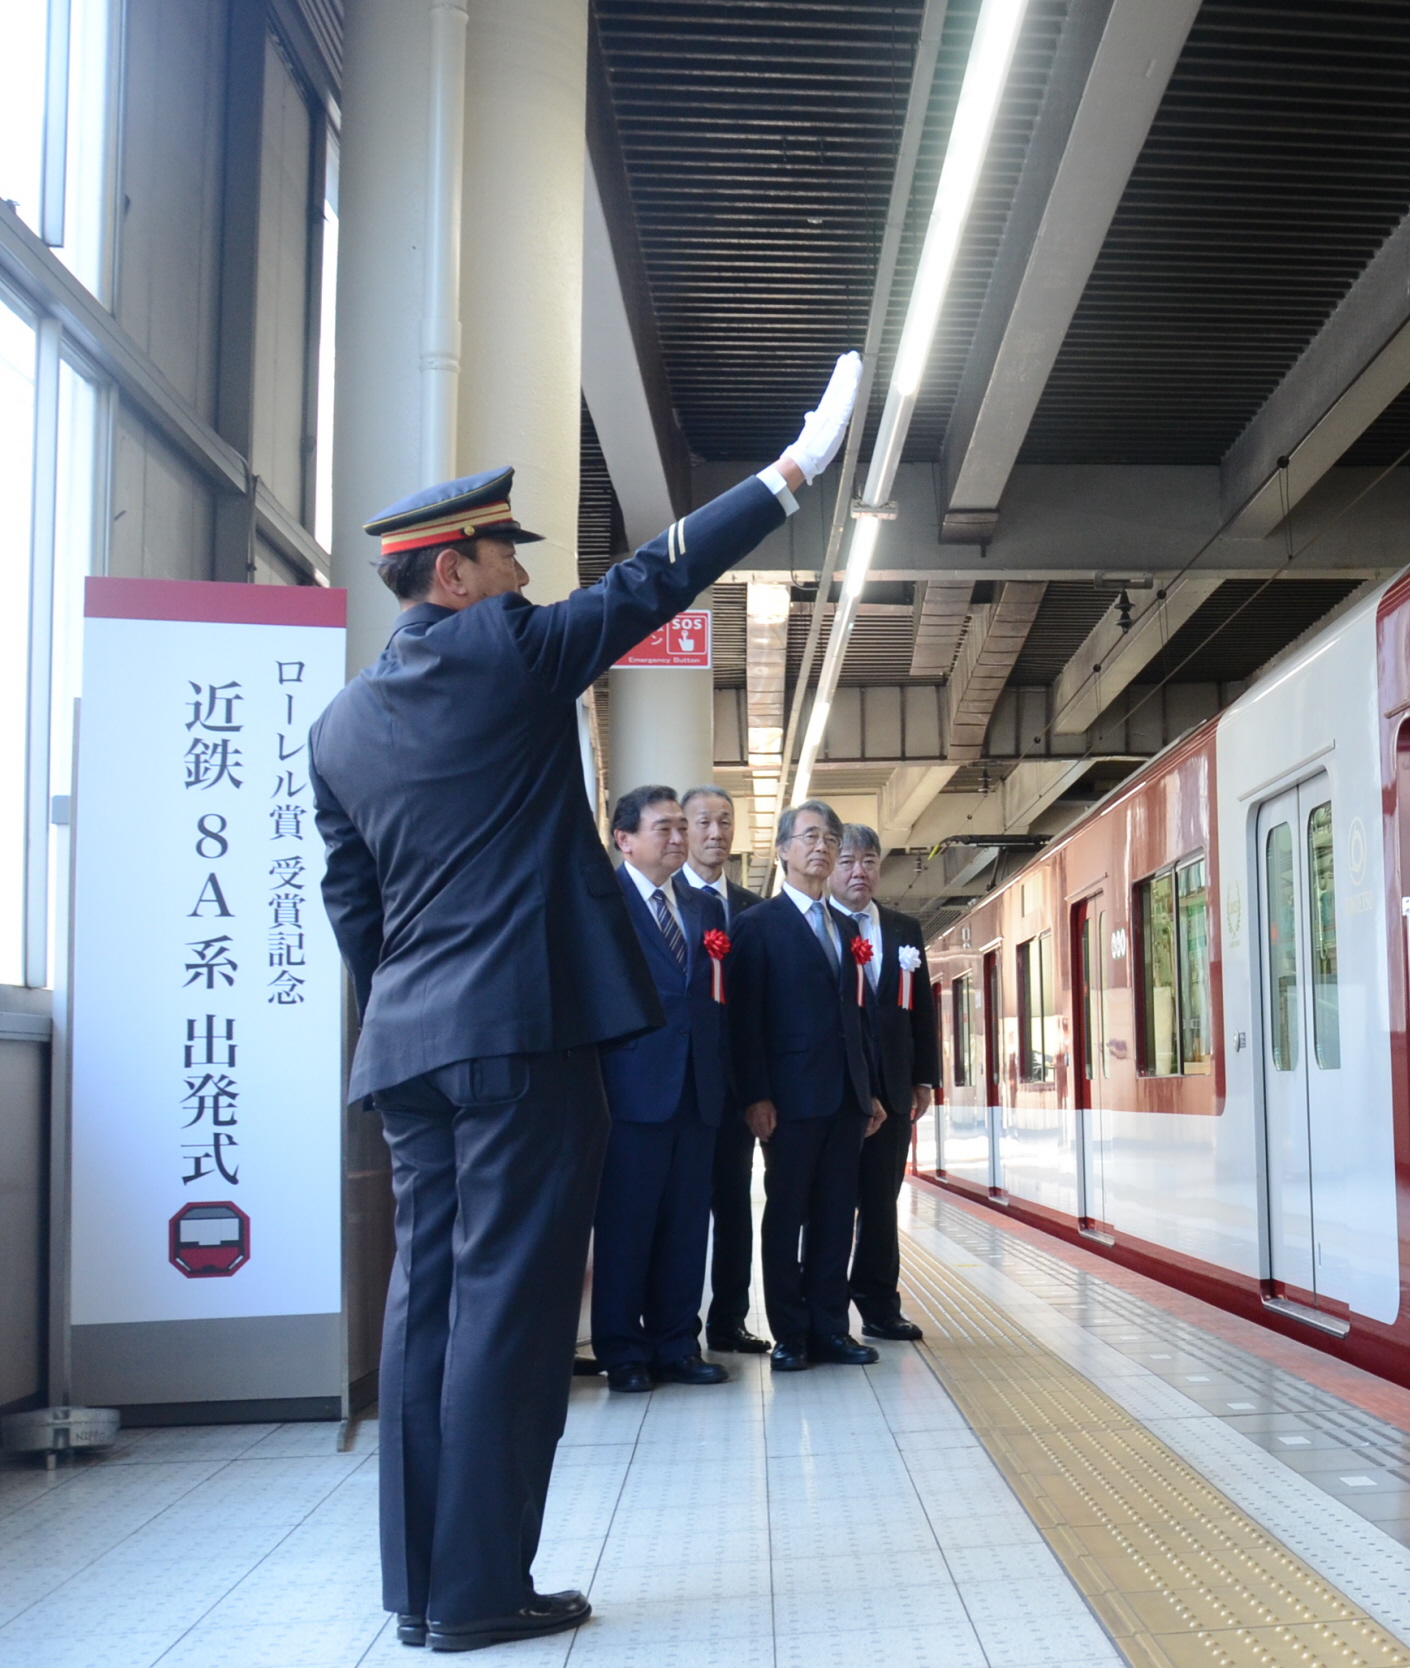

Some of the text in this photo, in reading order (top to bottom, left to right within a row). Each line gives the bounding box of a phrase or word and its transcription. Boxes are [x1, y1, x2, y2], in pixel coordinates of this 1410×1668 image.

[628, 656, 700, 664] Emergency Button
[672, 618, 702, 630] SOS
[267, 660, 307, 1005] ローレル賞 受賞記念
[179, 1013, 241, 1187] 出発式
